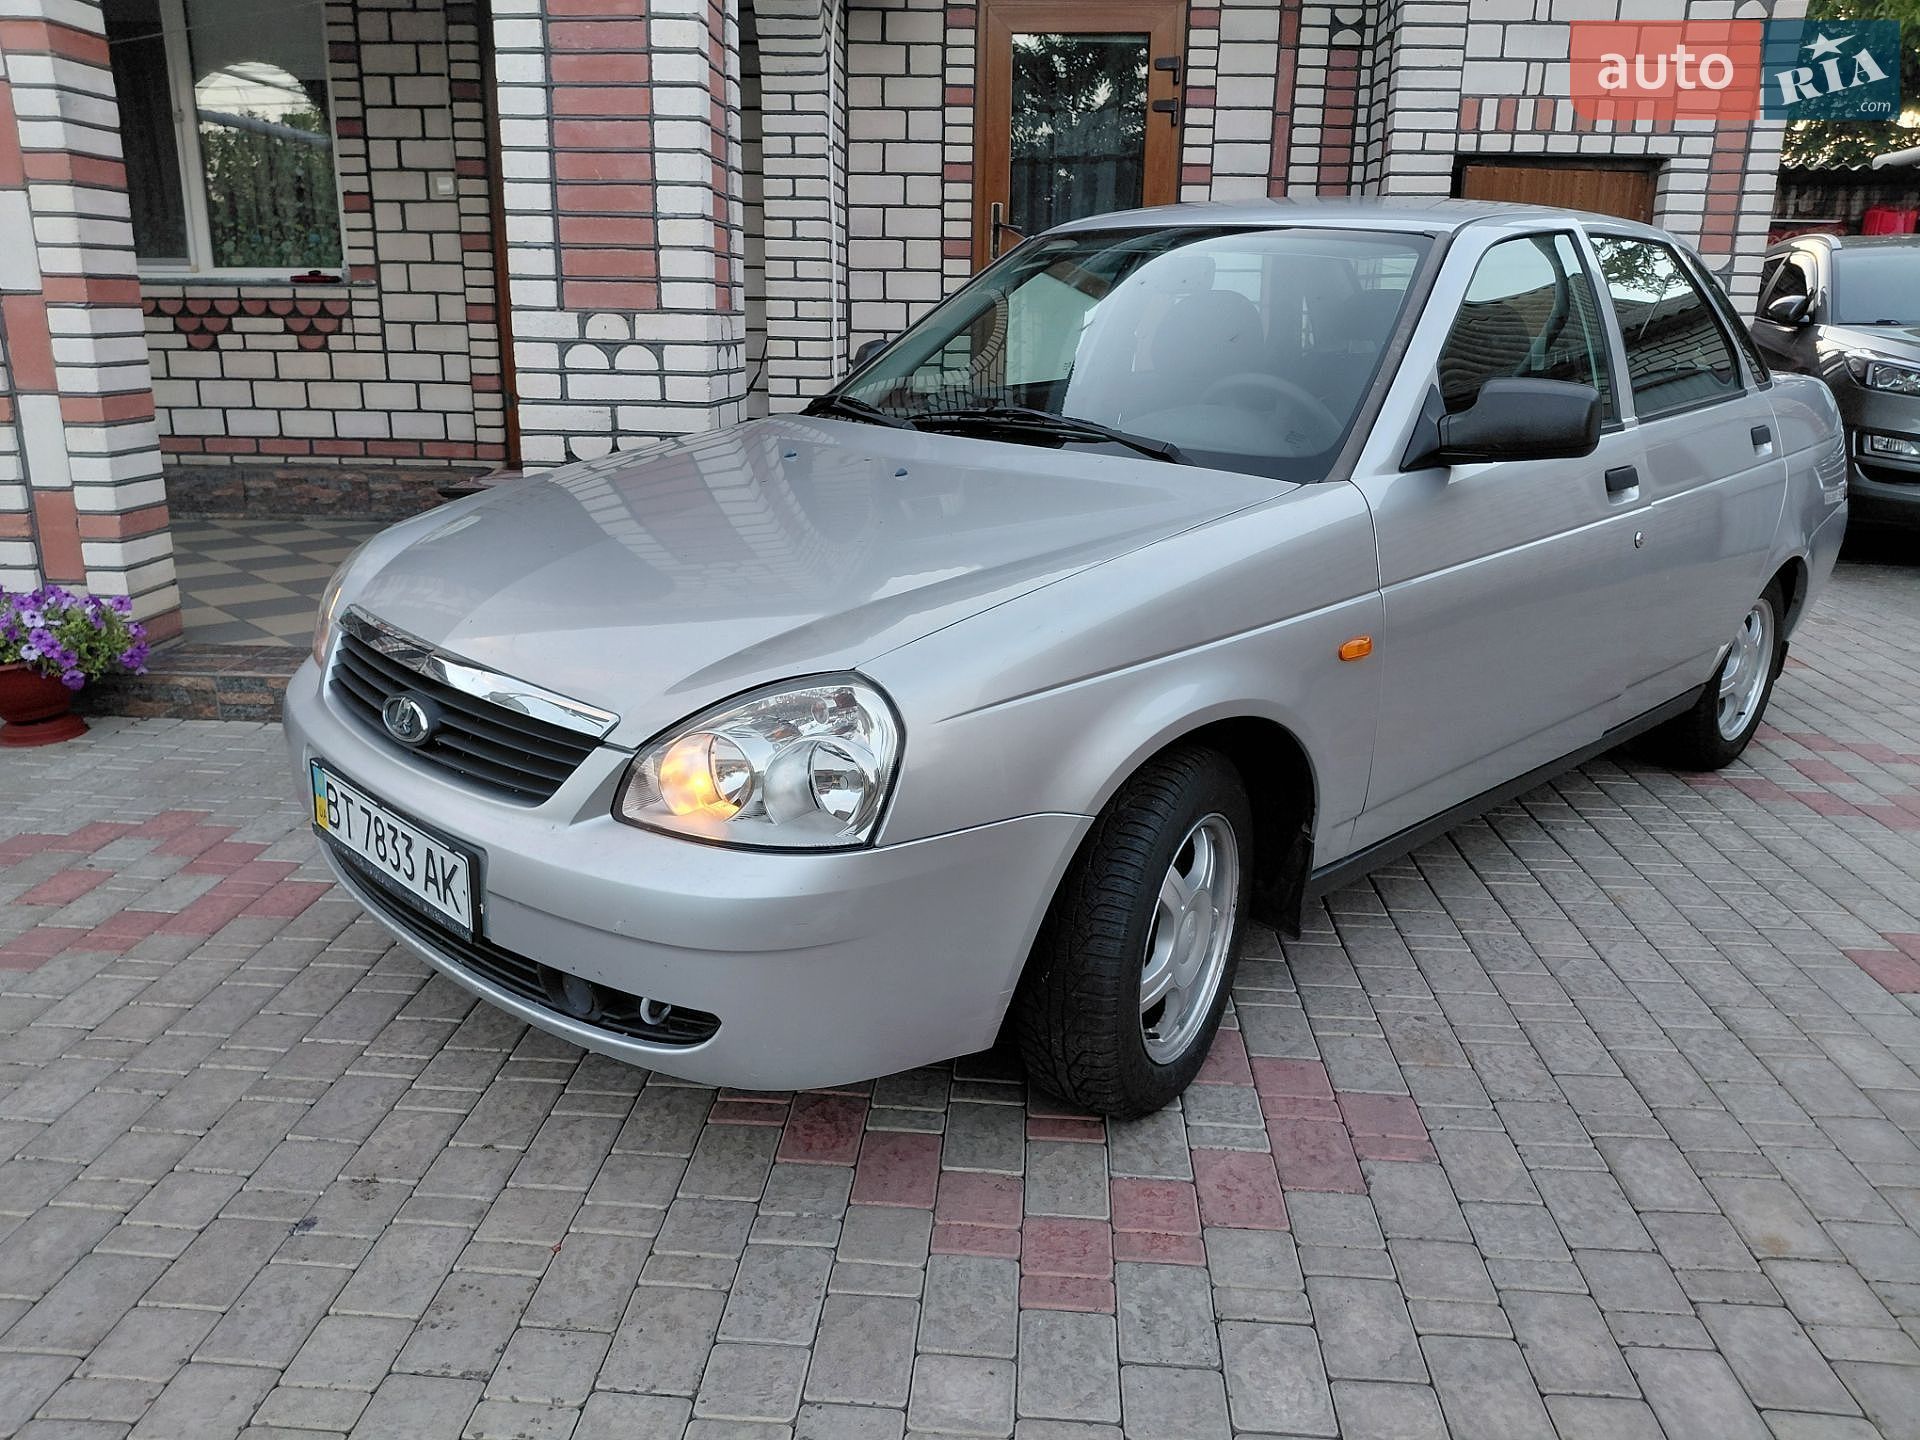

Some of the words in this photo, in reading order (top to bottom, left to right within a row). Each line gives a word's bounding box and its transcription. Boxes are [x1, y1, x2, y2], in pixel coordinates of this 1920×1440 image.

[326, 781, 353, 840] BT
[360, 806, 415, 882] 7833
[424, 847, 461, 915] AK
